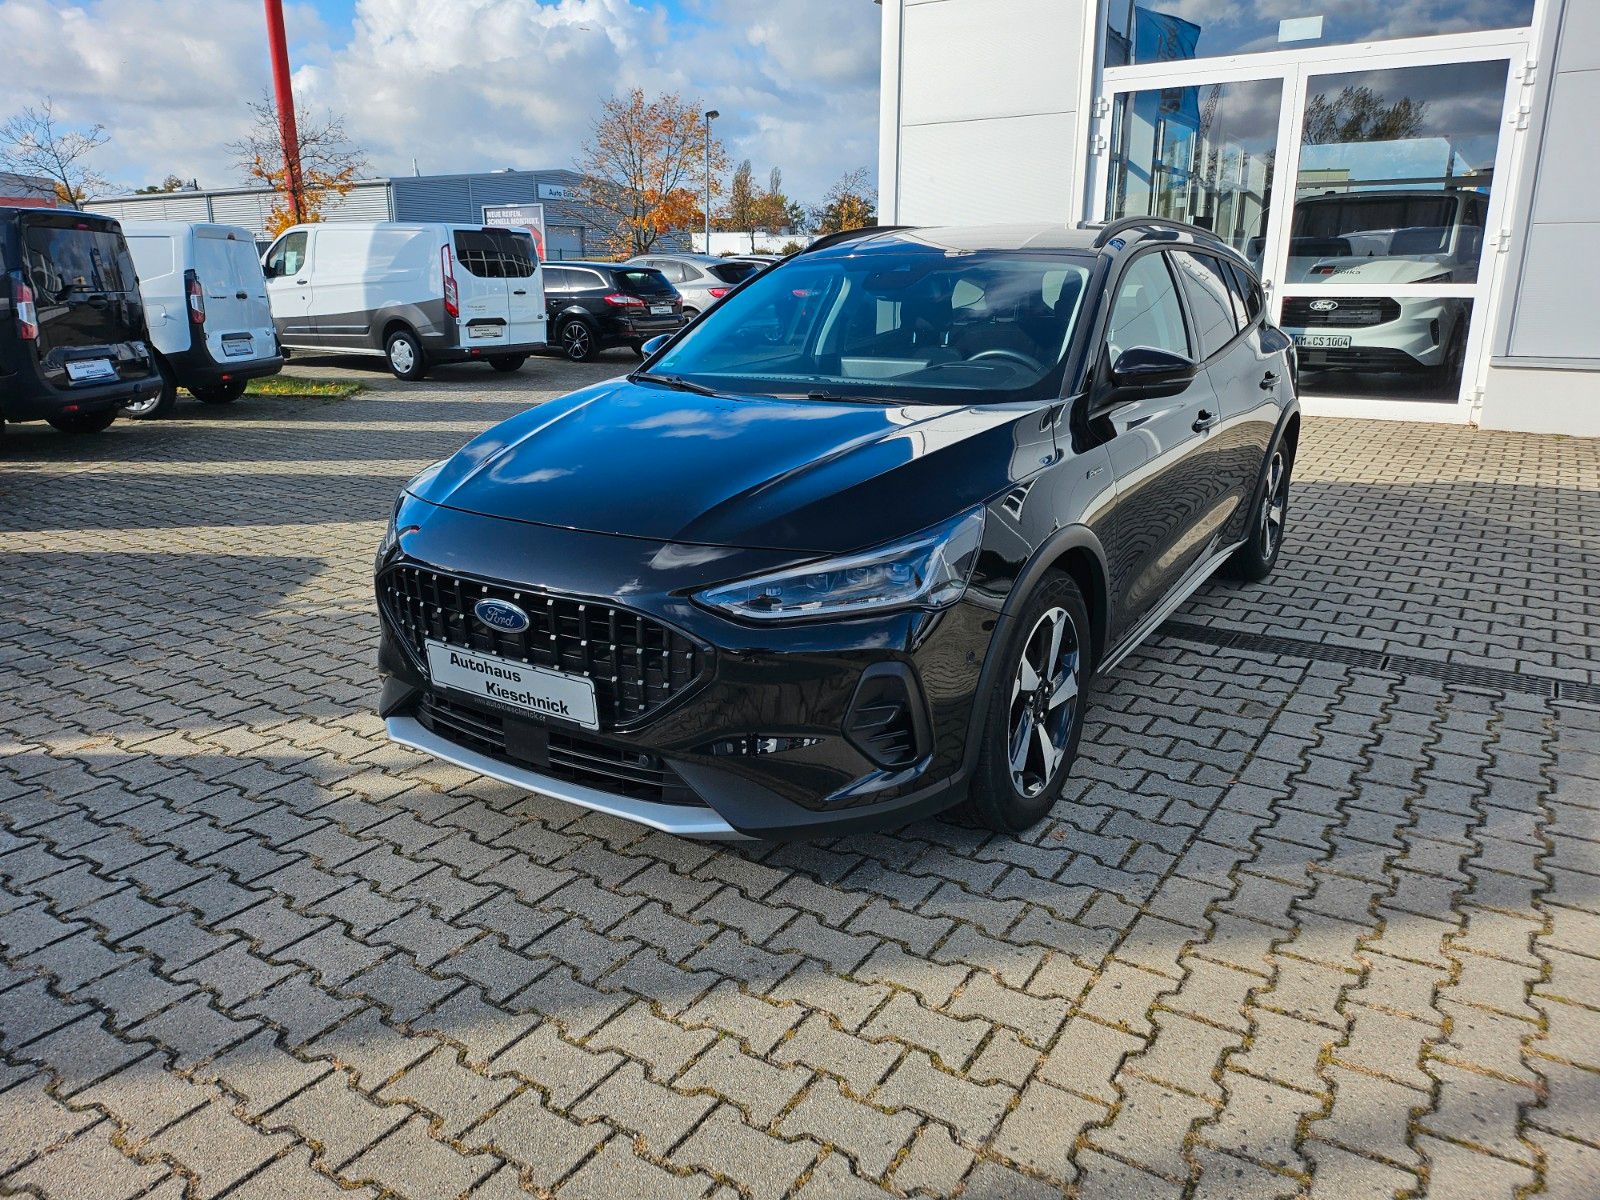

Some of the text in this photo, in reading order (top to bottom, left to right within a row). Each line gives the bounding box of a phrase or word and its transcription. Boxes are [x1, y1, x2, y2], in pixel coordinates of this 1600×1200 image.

[548, 188, 562, 197] Auto
[1295, 335, 1348, 347] KM CS 1004
[485, 606, 515, 627] Ford
[450, 652, 521, 683] Autohaus
[485, 681, 570, 716] Kieschnick
